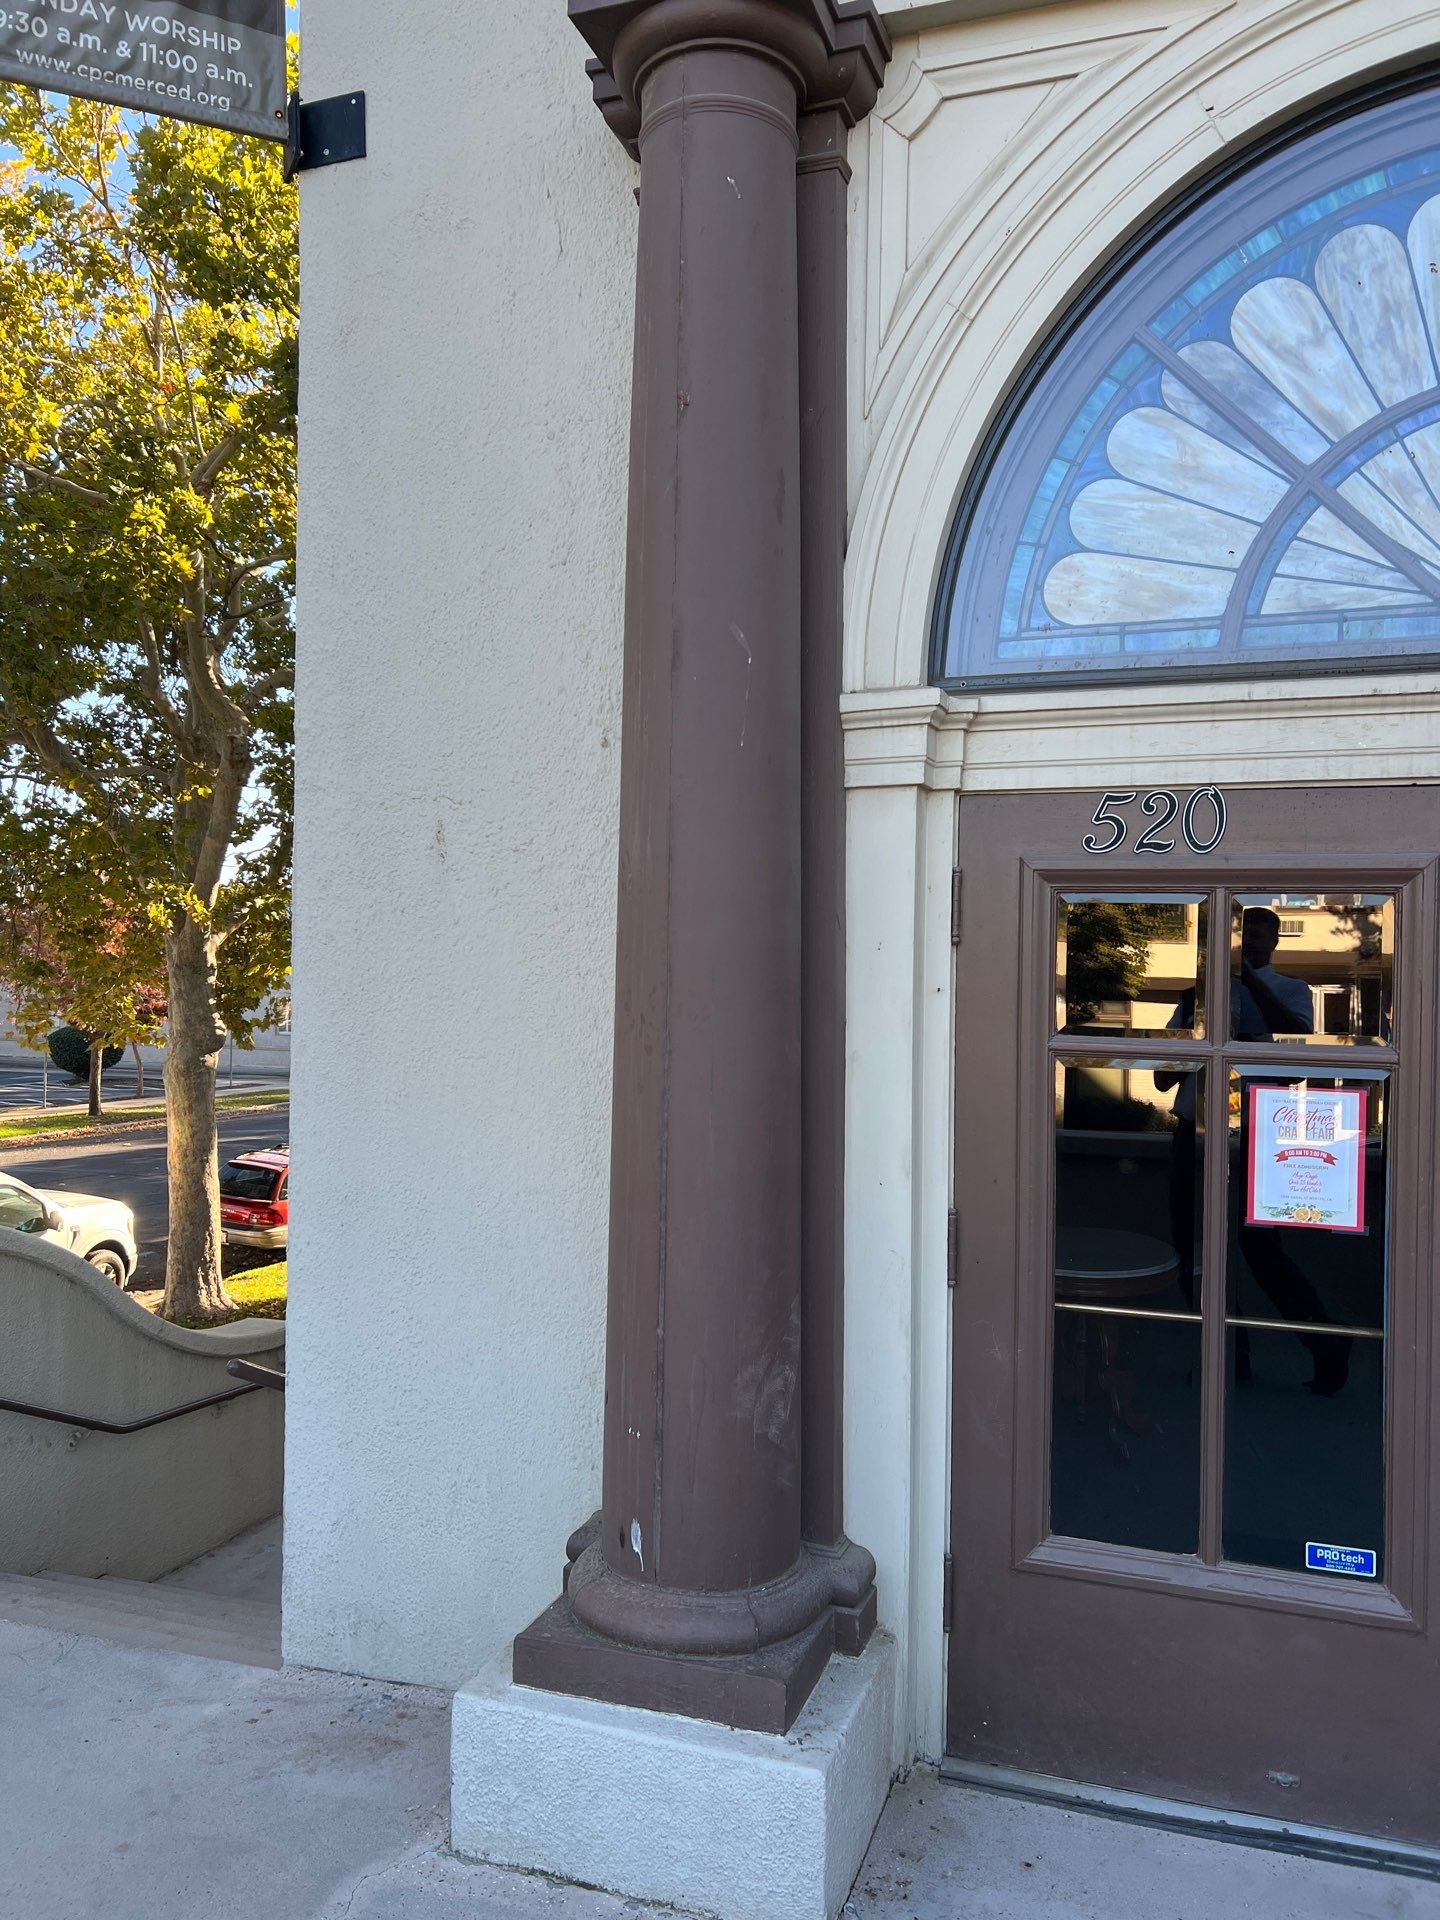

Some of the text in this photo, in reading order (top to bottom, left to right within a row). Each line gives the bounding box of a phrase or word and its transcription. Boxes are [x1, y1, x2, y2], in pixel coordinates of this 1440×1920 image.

[57, 27, 108, 54] a.m.
[115, 40, 132, 58] &
[139, 42, 198, 74] 11:00
[205, 63, 253, 88] a.m.
[125, 10, 241, 55] WORSHIP
[16, 49, 231, 111] www.cpcmerced.org
[1082, 785, 1228, 854] 520
[1278, 1126, 1309, 1139] CRAT
